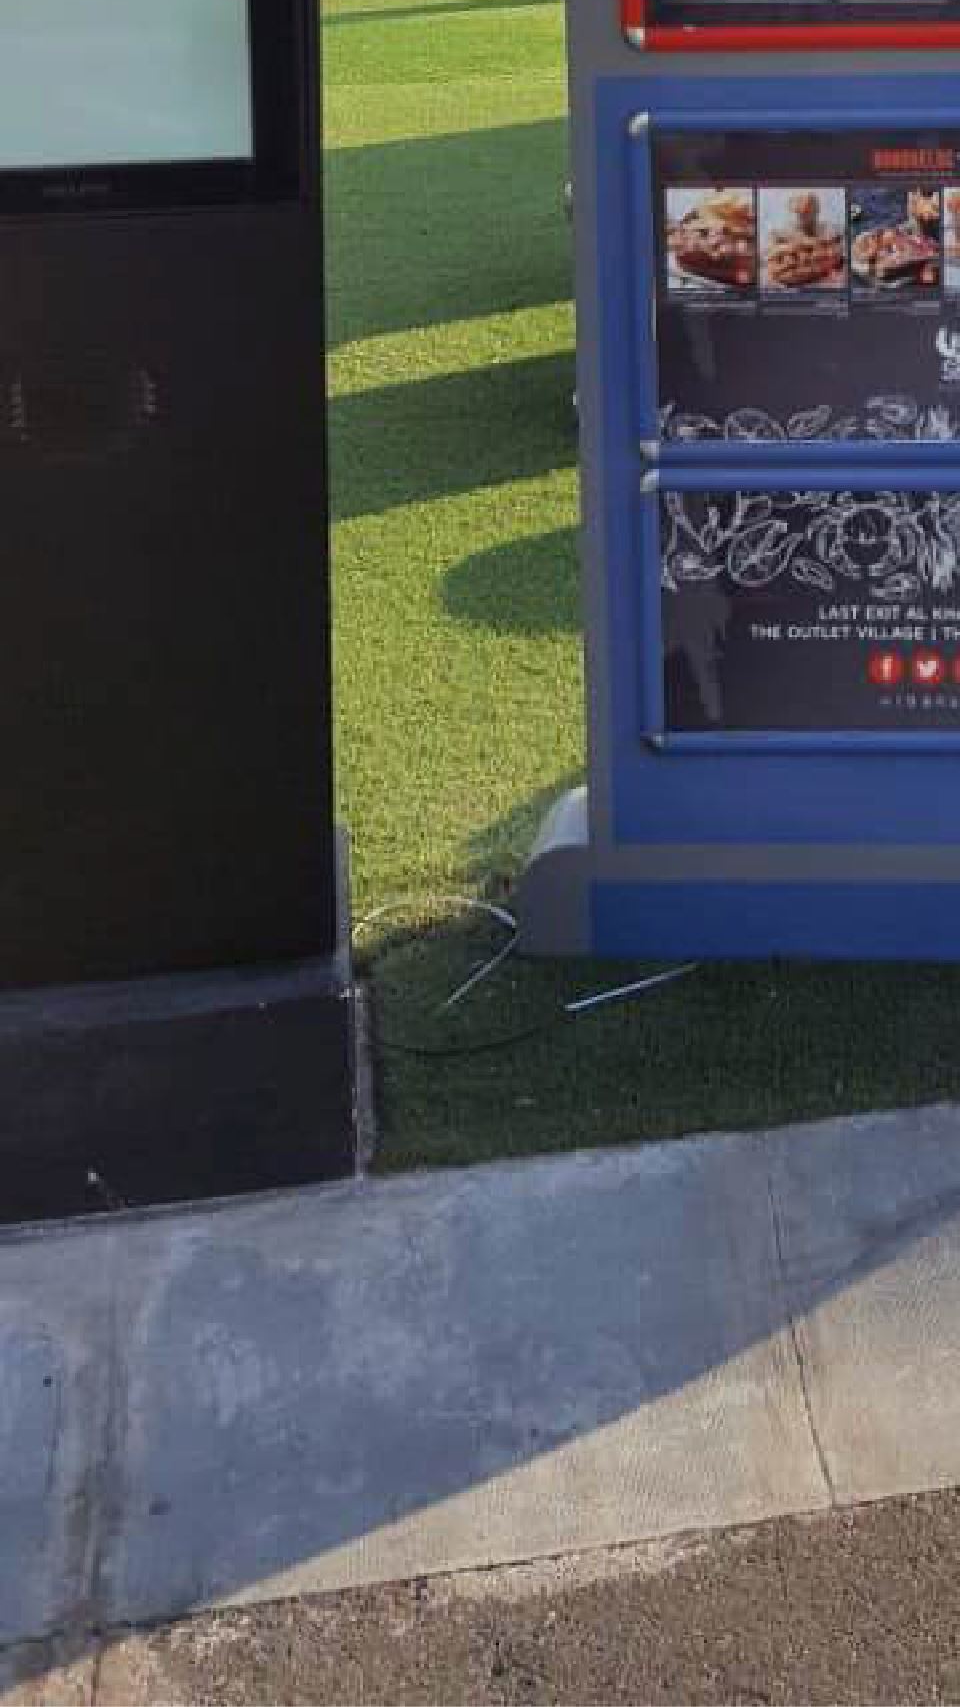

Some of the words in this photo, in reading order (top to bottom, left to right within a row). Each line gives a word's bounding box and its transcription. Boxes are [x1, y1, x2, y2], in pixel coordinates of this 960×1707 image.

[818, 605, 858, 621] LAST
[866, 605, 900, 621] EXIT
[907, 606, 928, 621] AL
[751, 624, 781, 640] THE
[788, 625, 849, 640] OUTLET
[856, 625, 924, 641] VILLAGE
